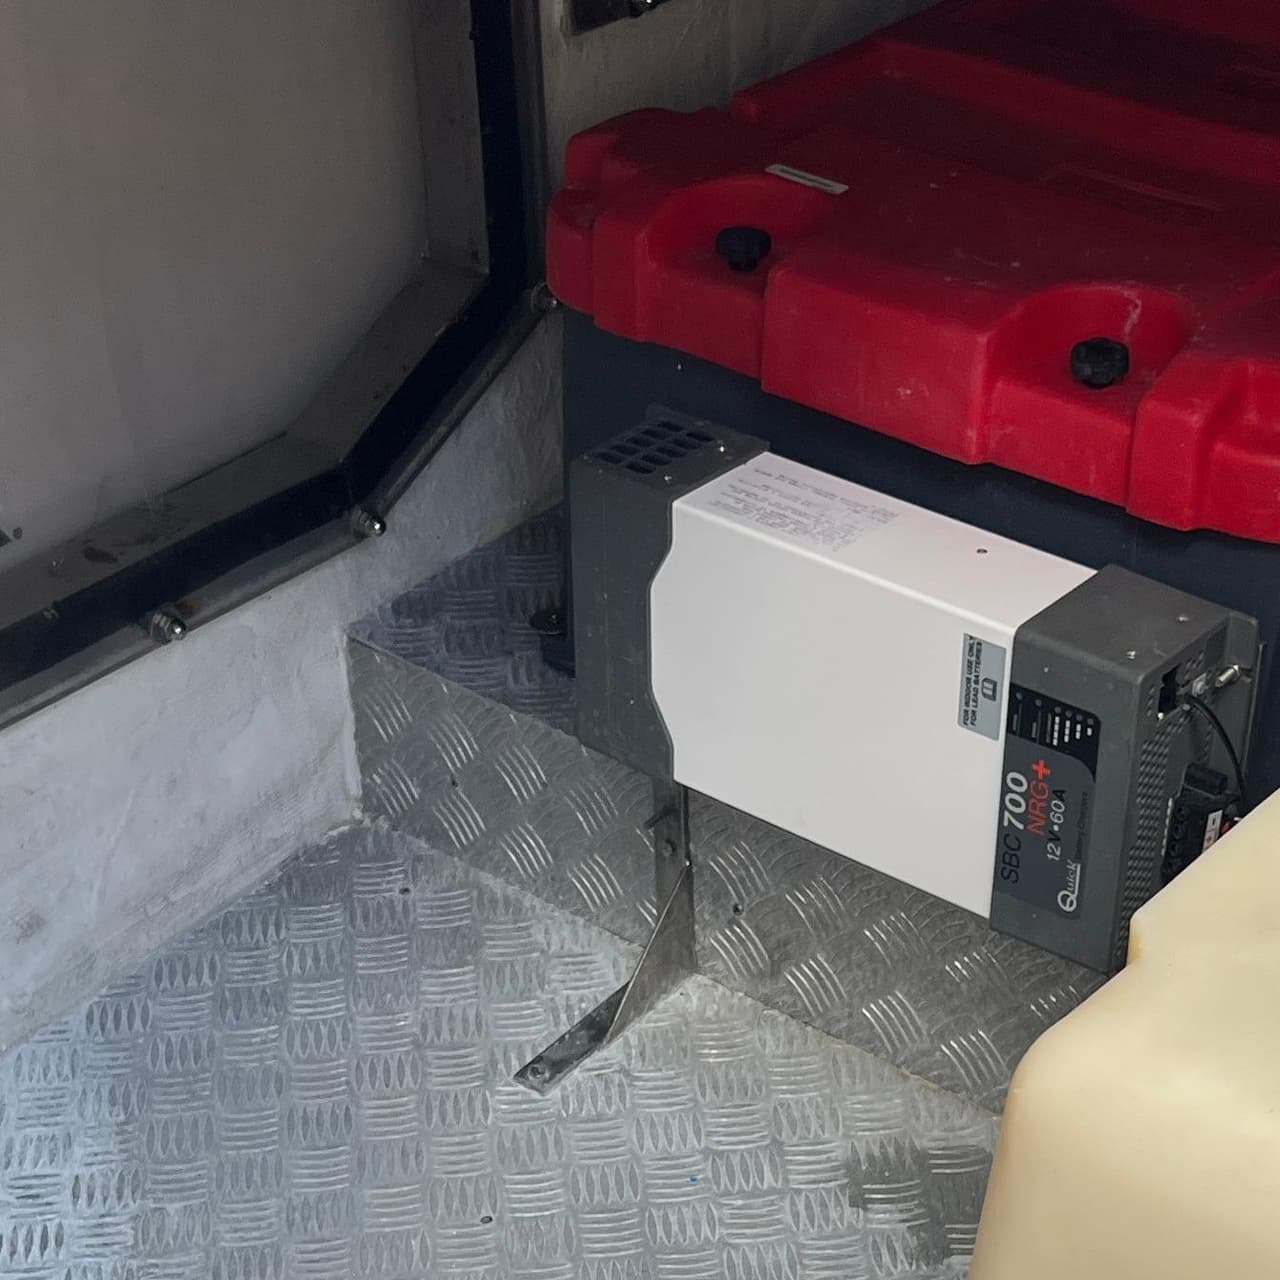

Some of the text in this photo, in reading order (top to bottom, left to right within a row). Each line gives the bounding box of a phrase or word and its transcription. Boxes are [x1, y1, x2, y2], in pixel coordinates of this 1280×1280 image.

[1000, 771, 1028, 884] SBC 700
[1057, 859, 1081, 912] Quick
